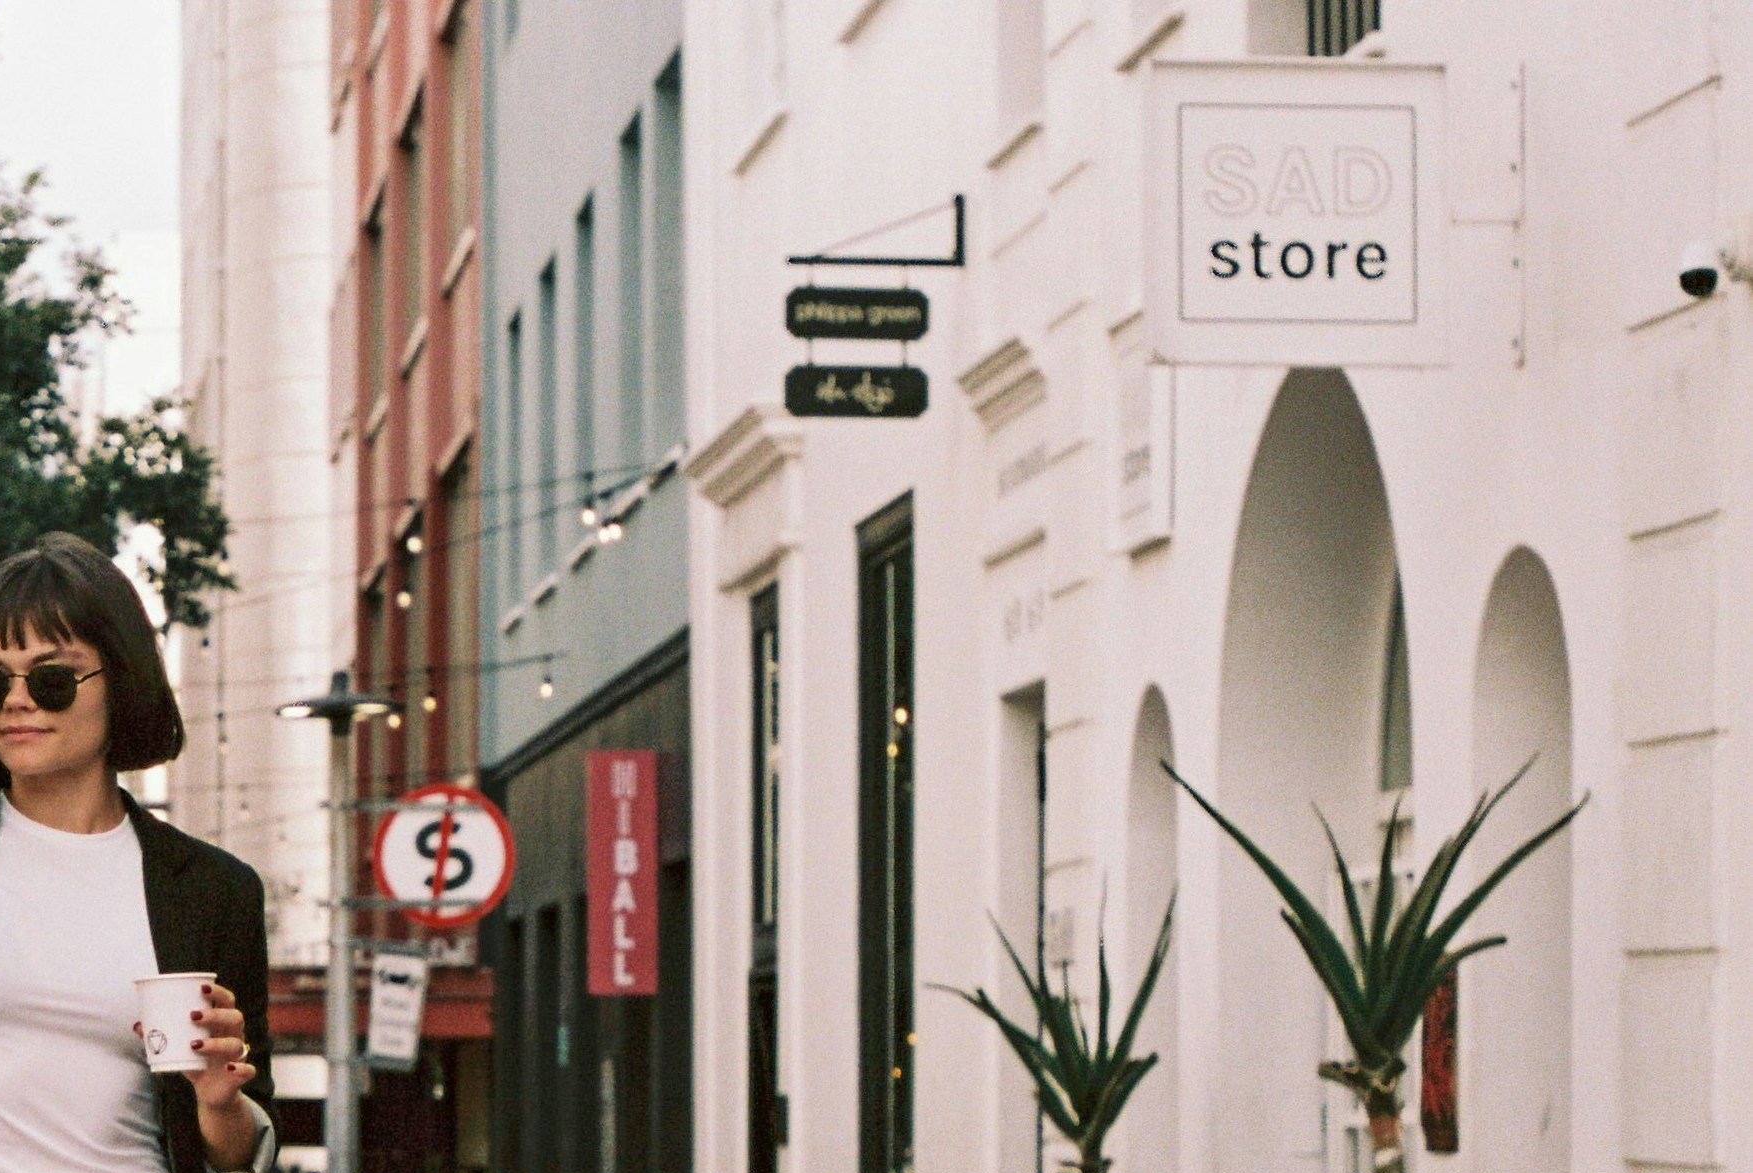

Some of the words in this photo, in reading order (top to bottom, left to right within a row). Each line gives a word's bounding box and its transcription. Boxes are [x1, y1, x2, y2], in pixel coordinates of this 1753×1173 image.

[1203, 142, 1394, 218] SAD
[1209, 231, 1389, 281] store
[414, 820, 474, 891] S
[610, 759, 639, 987] HIBALL
